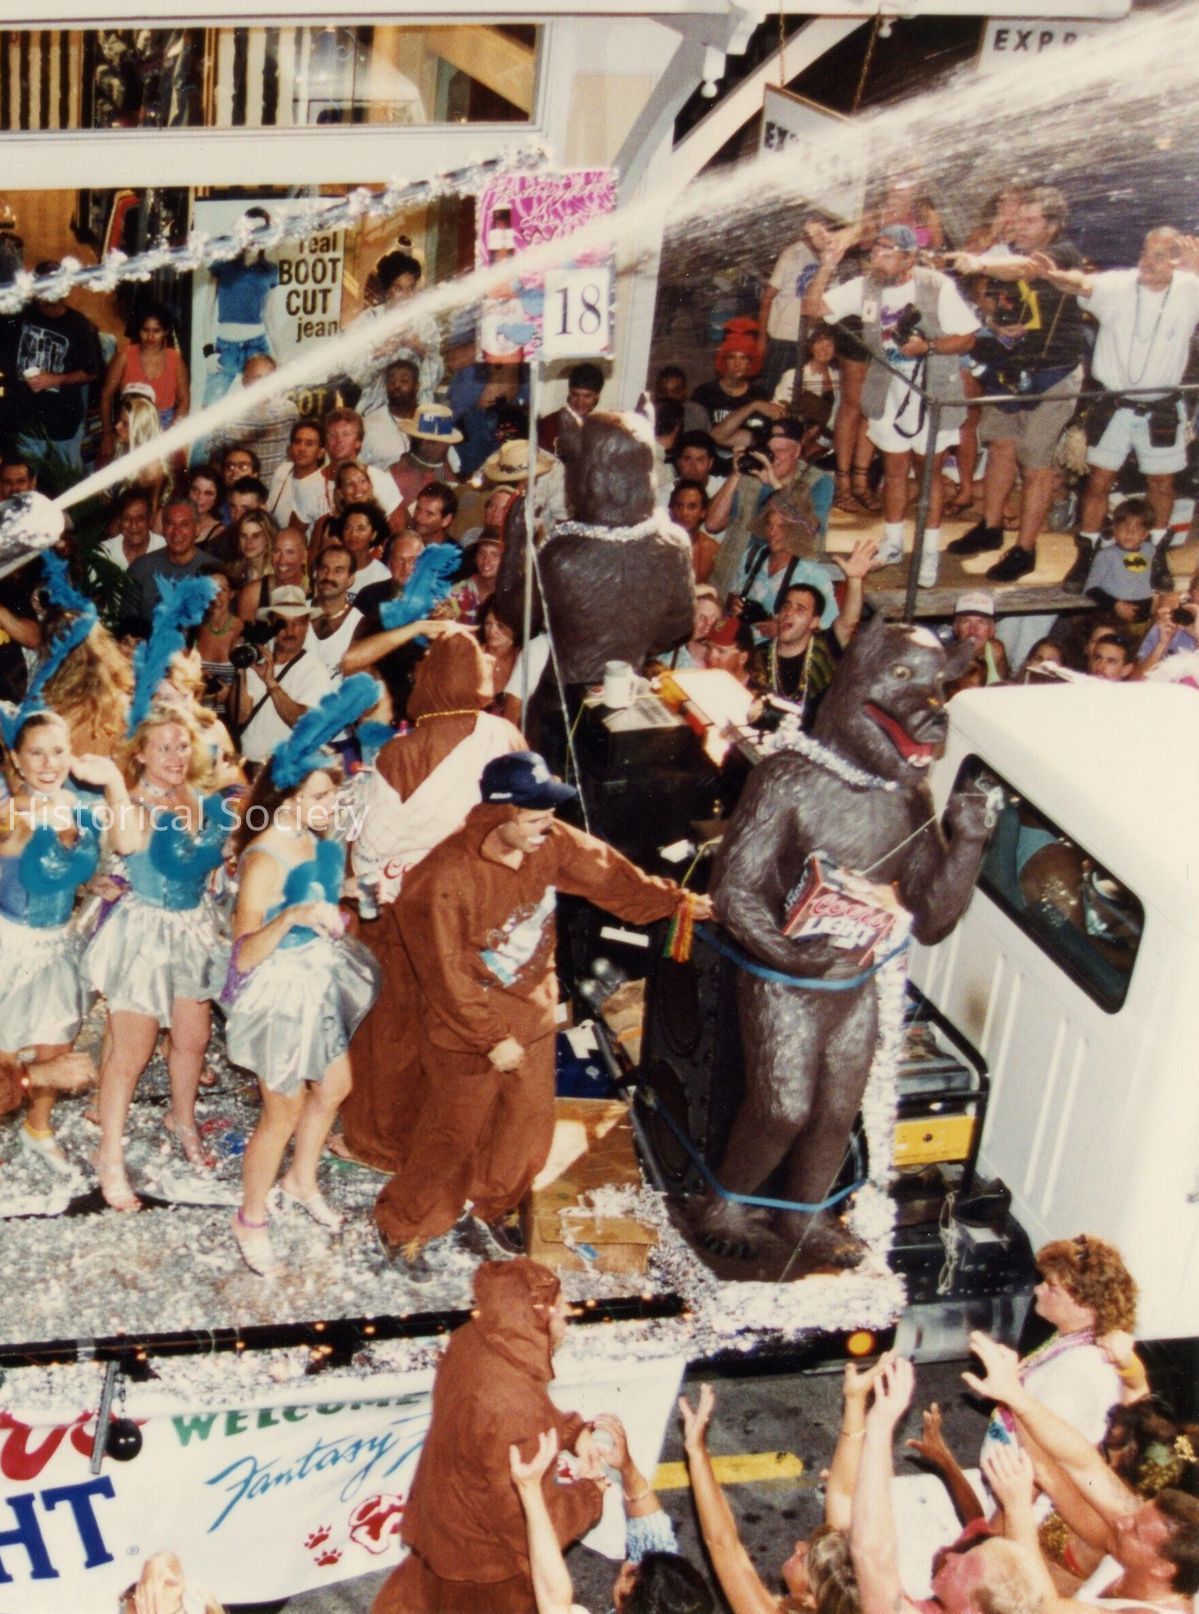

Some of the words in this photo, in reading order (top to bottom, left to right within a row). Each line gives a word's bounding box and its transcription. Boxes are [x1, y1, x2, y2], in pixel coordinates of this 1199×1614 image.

[279, 258, 341, 286] BOOT
[286, 288, 331, 316] CUT
[555, 284, 602, 336] 18
[171, 1391, 429, 1447] WELC
[205, 1431, 394, 1534] Fantasy
